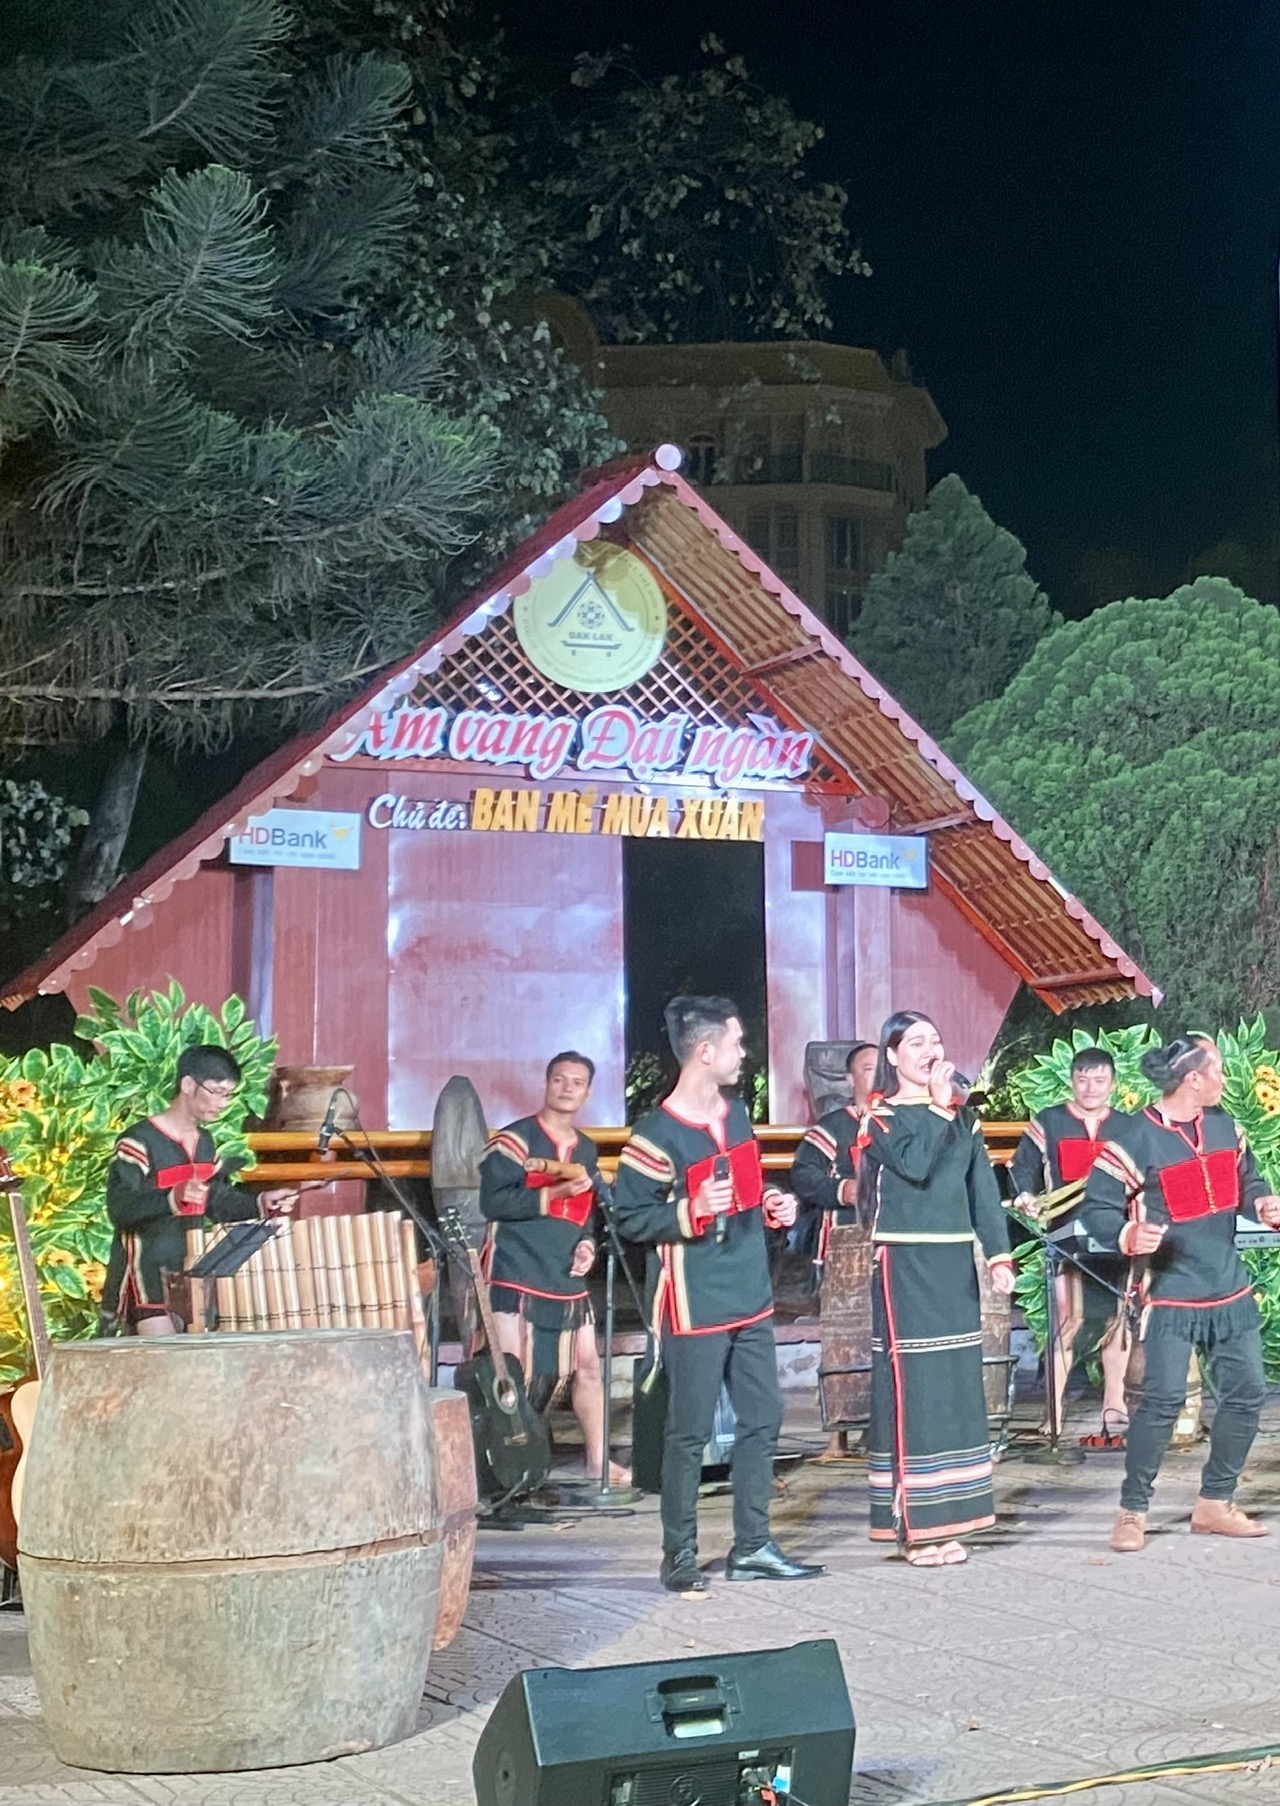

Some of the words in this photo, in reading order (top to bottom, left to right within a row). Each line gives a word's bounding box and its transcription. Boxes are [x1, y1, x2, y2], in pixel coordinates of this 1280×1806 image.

[451, 709, 576, 778] vang
[579, 706, 687, 779] Đại
[686, 714, 812, 787] ngàn
[368, 793, 426, 830] Chủ
[471, 787, 541, 832] BAN
[600, 784, 671, 838] MÙA
[675, 789, 765, 842] XUÂN
[239, 827, 328, 850] HDBank
[830, 849, 901, 870] HDBank
